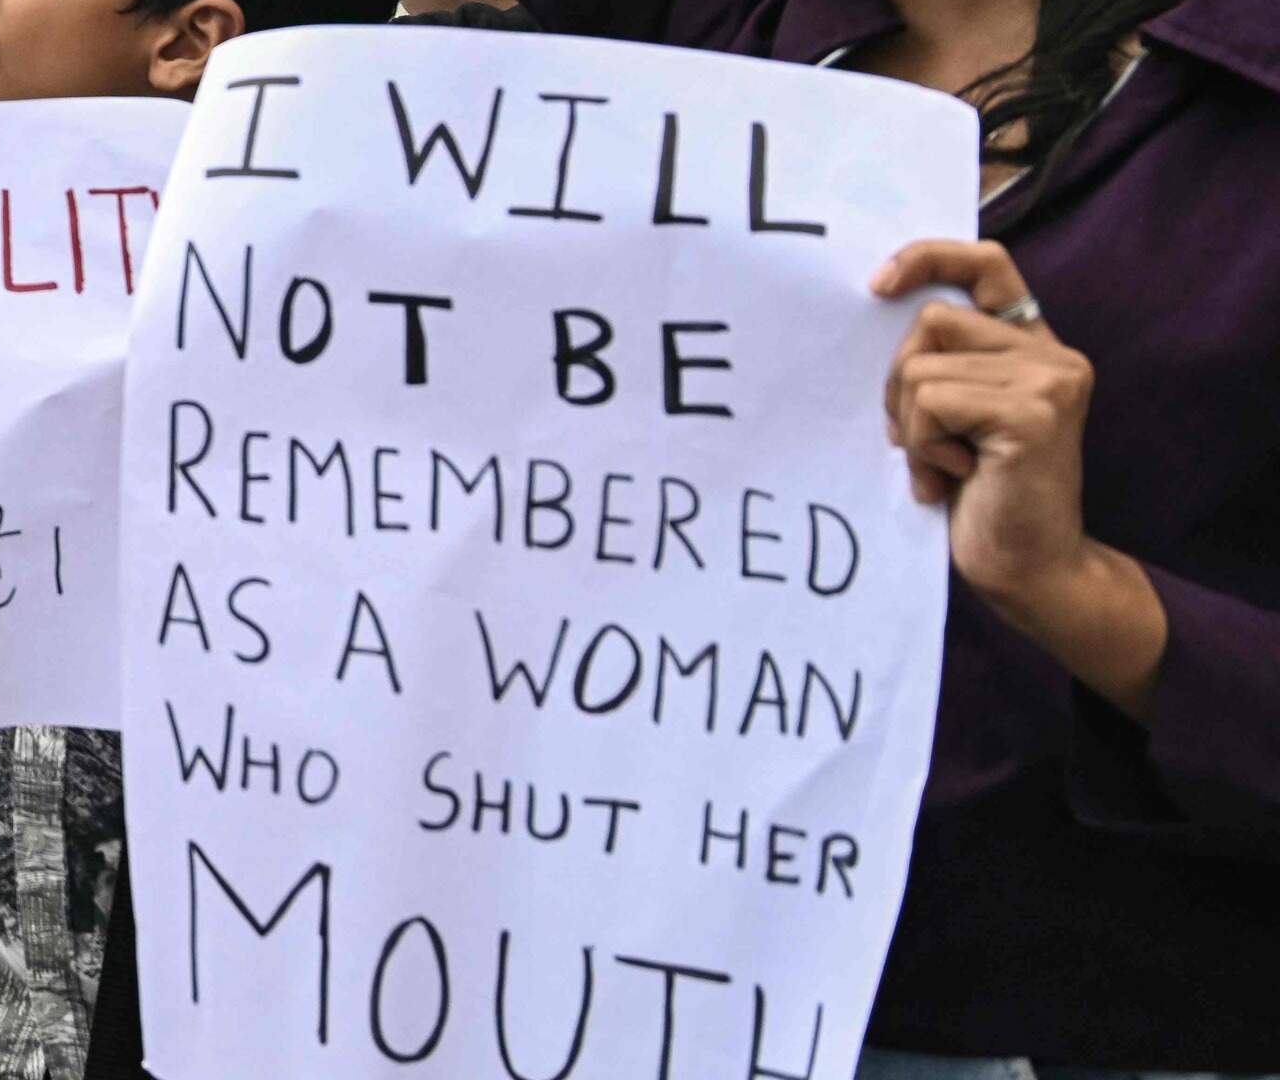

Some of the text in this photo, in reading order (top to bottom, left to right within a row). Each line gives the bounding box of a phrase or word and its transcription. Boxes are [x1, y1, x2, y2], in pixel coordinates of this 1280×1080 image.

[206, 76, 827, 238] I WILL
[176, 241, 735, 420] NOT BE
[167, 399, 862, 598] REMEMBERED
[157, 562, 862, 742] AS A WOMAN
[165, 701, 862, 899] WHO SHUT HER
